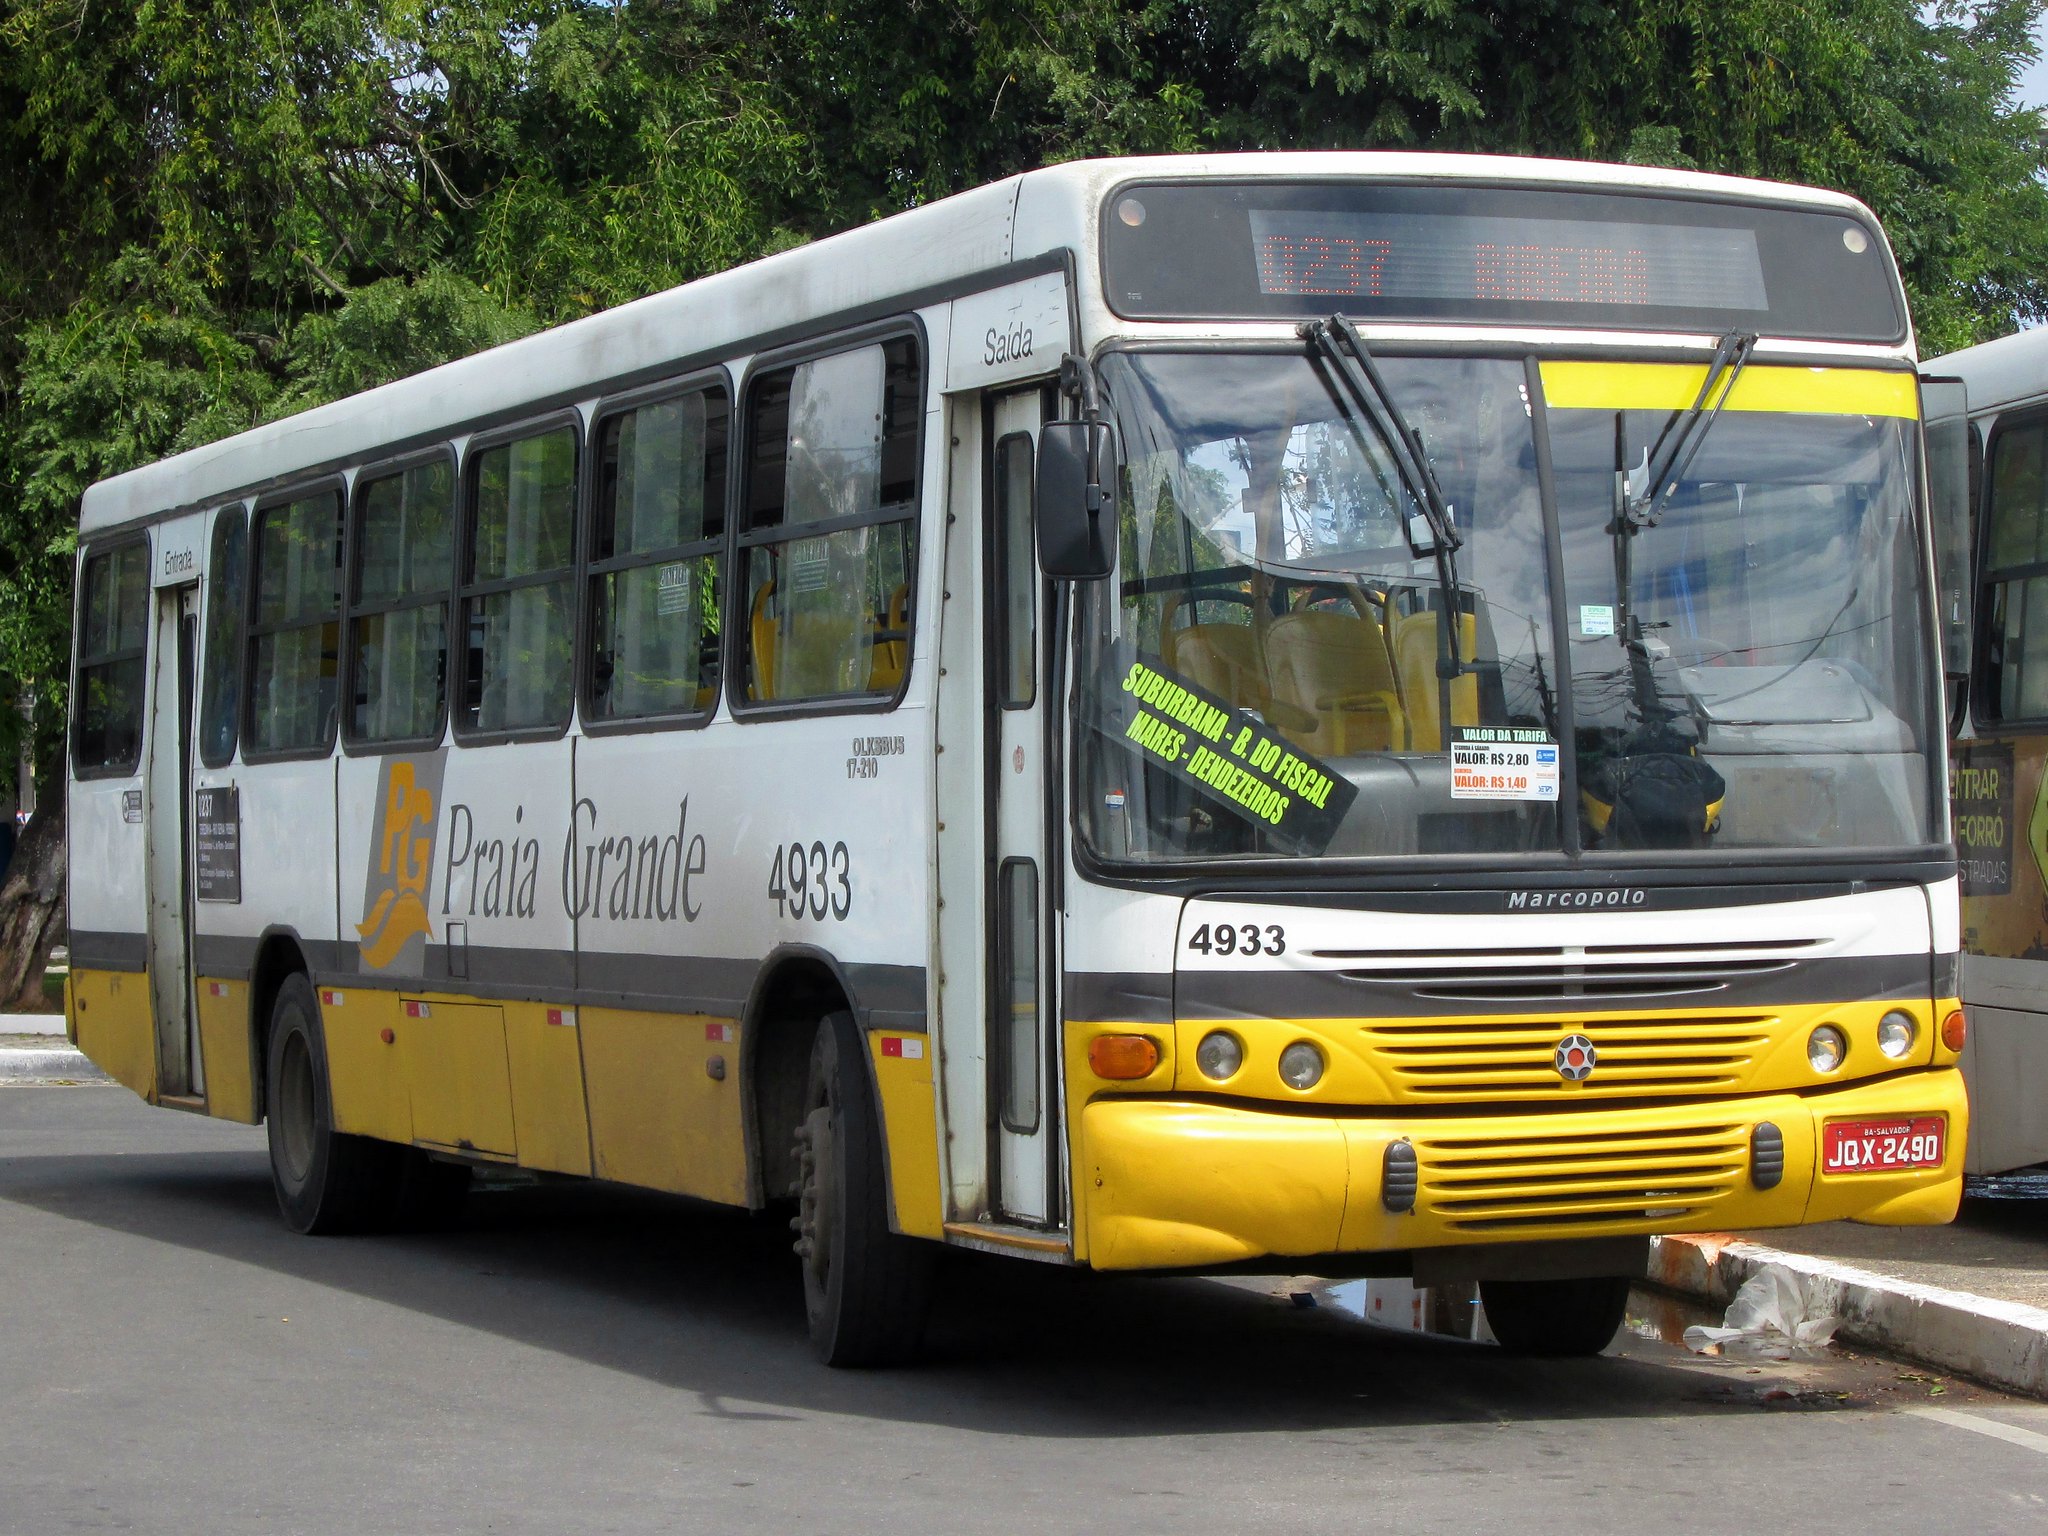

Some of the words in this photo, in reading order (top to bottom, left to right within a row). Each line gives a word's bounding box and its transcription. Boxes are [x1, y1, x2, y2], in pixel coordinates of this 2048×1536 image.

[1263, 236, 1390, 294] 0237
[1475, 244, 1647, 304] RIBEIRA
[984, 321, 1033, 366] Saída
[165, 546, 192, 576] Entrada
[1122, 662, 1230, 743] SUBURBANA
[1249, 738, 1282, 774] DO
[1272, 752, 1335, 810] FISCAL
[1462, 729, 1495, 741] VALOR
[1497, 729, 1512, 741] DA
[1513, 730, 1548, 742] TARIFA
[846, 757, 878, 779] 17-210
[1125, 709, 1187, 762] MARES
[1186, 745, 1290, 826] DENDEZEIROS
[1454, 752, 1488, 765] VALOR:
[1491, 753, 1504, 766] R$
[1507, 753, 1530, 767] 2,80
[1454, 775, 1488, 788] VALOR:
[1491, 776, 1504, 789] R$
[1507, 776, 1528, 790] 1,40
[380, 762, 433, 894] PG
[1958, 807, 2004, 847] FORRÓ
[442, 804, 540, 918] Praia
[562, 792, 706, 923] Grande
[1957, 860, 2007, 884] STRADAS
[768, 841, 851, 921] 4933
[1508, 889, 1645, 908] Marcopolo
[1188, 923, 1287, 957] 4933
